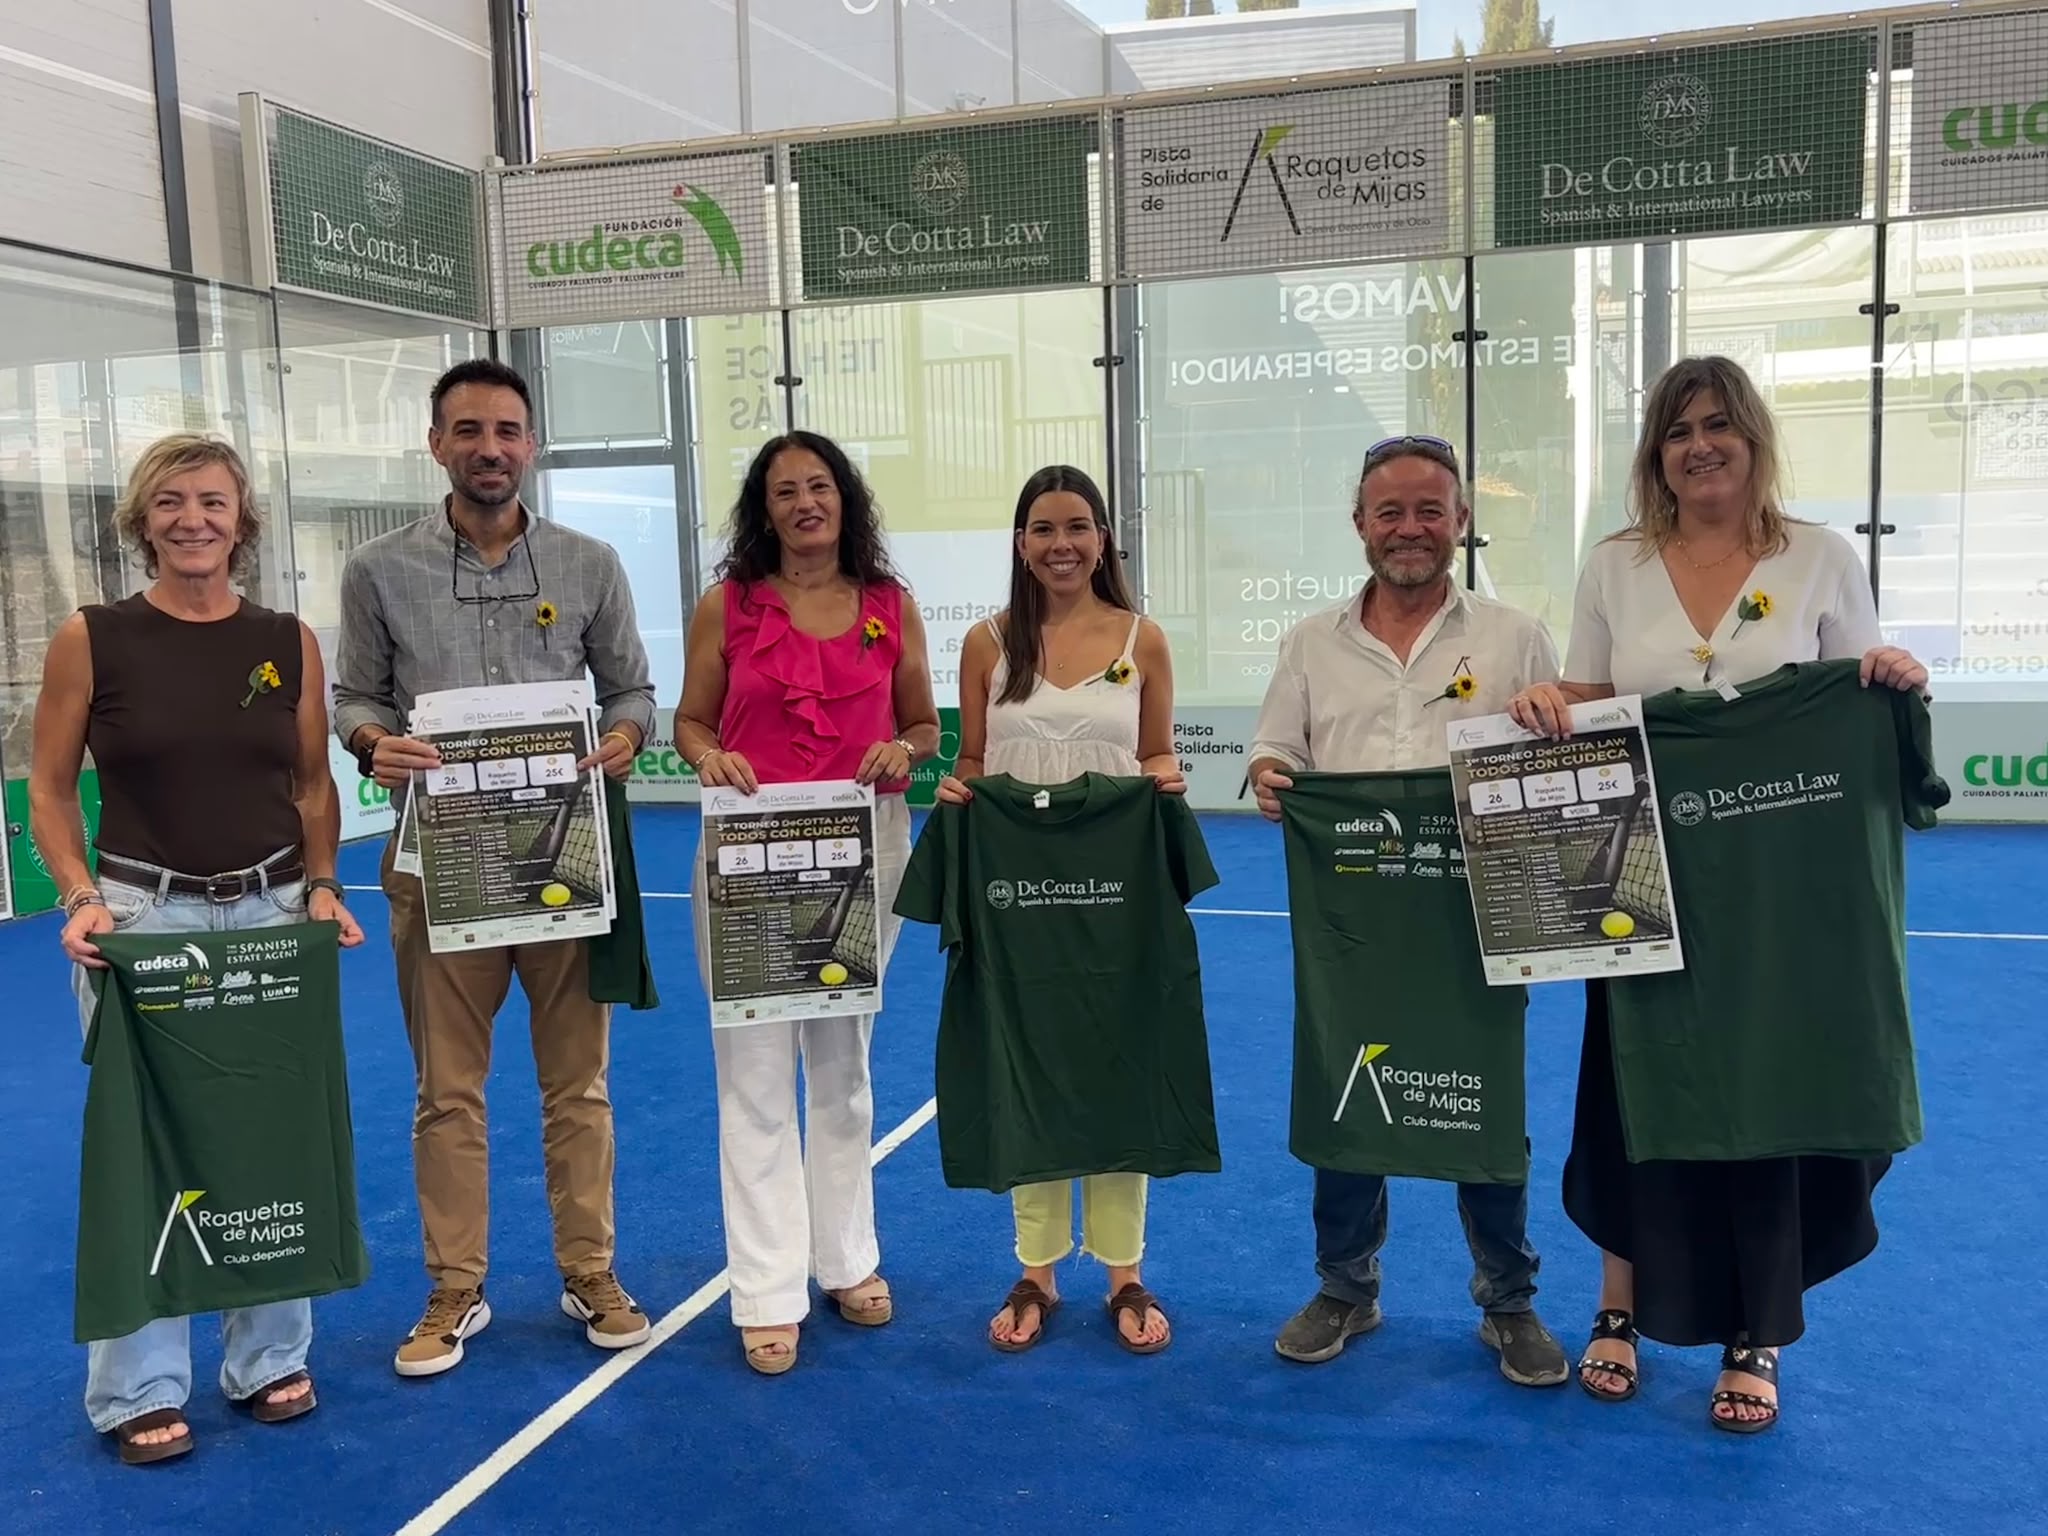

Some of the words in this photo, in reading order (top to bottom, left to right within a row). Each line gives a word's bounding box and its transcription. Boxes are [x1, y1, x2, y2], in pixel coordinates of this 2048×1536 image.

[1141, 147, 1191, 163] Pista
[1941, 154, 2002, 167] CUIDADOS
[1287, 146, 1426, 182] Raquetas
[1540, 162, 1593, 199] De
[1603, 156, 1714, 194] Cotta
[1724, 146, 1814, 184] Law
[1140, 166, 1228, 188] Solidaria
[1318, 179, 1346, 201] de
[1353, 177, 1427, 208] Mijas
[1140, 196, 1165, 212] de
[1540, 203, 1601, 224] Spanish
[1606, 202, 1623, 218] &
[1628, 194, 1736, 218] International
[1741, 189, 1813, 209] Lawyers
[604, 216, 684, 233] FUNDACIÓN
[311, 210, 345, 251] De
[349, 222, 409, 268] Cotta
[412, 238, 456, 279] Law
[836, 226, 880, 260] De
[885, 222, 974, 255] Cotta
[980, 214, 1050, 248] Law
[526, 223, 684, 278] cudeca
[312, 254, 351, 275] Spanish
[352, 264, 363, 279] &
[364, 265, 423, 293] International
[837, 265, 887, 285] Spanish
[890, 264, 903, 277] &
[906, 256, 992, 276] International
[996, 252, 1050, 272] Lawyers
[528, 278, 568, 290] CUIDADOS
[1590, 711, 1622, 725] cudeca
[1173, 723, 1214, 737] Pista
[439, 737, 490, 751] TORNEO
[491, 733, 546, 746] DeCOTTA
[546, 729, 574, 740] LAW
[1173, 740, 1245, 755] Solidaria
[480, 745, 512, 758] CON
[514, 740, 575, 754] CUDECA
[1481, 750, 1534, 764] TORNEO
[1535, 743, 1595, 759] DeCOTTA
[1597, 737, 1628, 748] LAW
[1467, 762, 1521, 780] TODOS
[1523, 758, 1559, 772] CON
[1561, 748, 1631, 768] CUDECA
[445, 776, 458, 786] 26
[545, 768, 564, 778] 25€
[1597, 779, 1619, 792] 25€
[1706, 788, 1737, 808] De
[1737, 780, 1795, 801] Cotta
[1795, 772, 1841, 791] Law
[1962, 789, 2011, 798] CUIDADOS
[1488, 794, 1503, 805] 26
[1711, 806, 1744, 821] Spanish
[1744, 804, 1754, 814] &
[1754, 794, 1808, 812] International
[1808, 790, 1844, 803] Lawyers
[733, 820, 780, 831] TORNEO
[781, 817, 833, 829] DeCOTTA
[834, 814, 861, 825] LAW
[1335, 818, 1384, 833] cudeca
[1419, 826, 1451, 835] ESTATE
[717, 832, 768, 843] TODOS
[769, 829, 801, 839] CON
[802, 825, 861, 837] CUDECA
[735, 857, 749, 866] 26
[831, 852, 849, 862] 25€
[1017, 880, 1040, 897] De
[1041, 878, 1087, 895] Cotta
[1088, 878, 1124, 894] Law
[1018, 898, 1044, 908] Spanish
[1045, 897, 1051, 905] &
[1052, 896, 1095, 905] International
[1096, 896, 1124, 906] Lawyers
[239, 938, 298, 955] SPANISH
[133, 955, 190, 972] cudeca
[226, 953, 261, 965] ESTATE
[264, 949, 298, 961] AGENT
[1381, 1065, 1483, 1091] Raquetas
[1402, 1087, 1426, 1102] de
[1429, 1092, 1482, 1116] Mijas
[1402, 1115, 1429, 1128] Club
[1430, 1118, 1482, 1132] deportivo
[199, 1200, 305, 1229] Raquetas
[222, 1227, 247, 1243] de
[250, 1222, 306, 1245] Mijas
[223, 1253, 251, 1265] Club
[251, 1246, 306, 1263] deportivo
